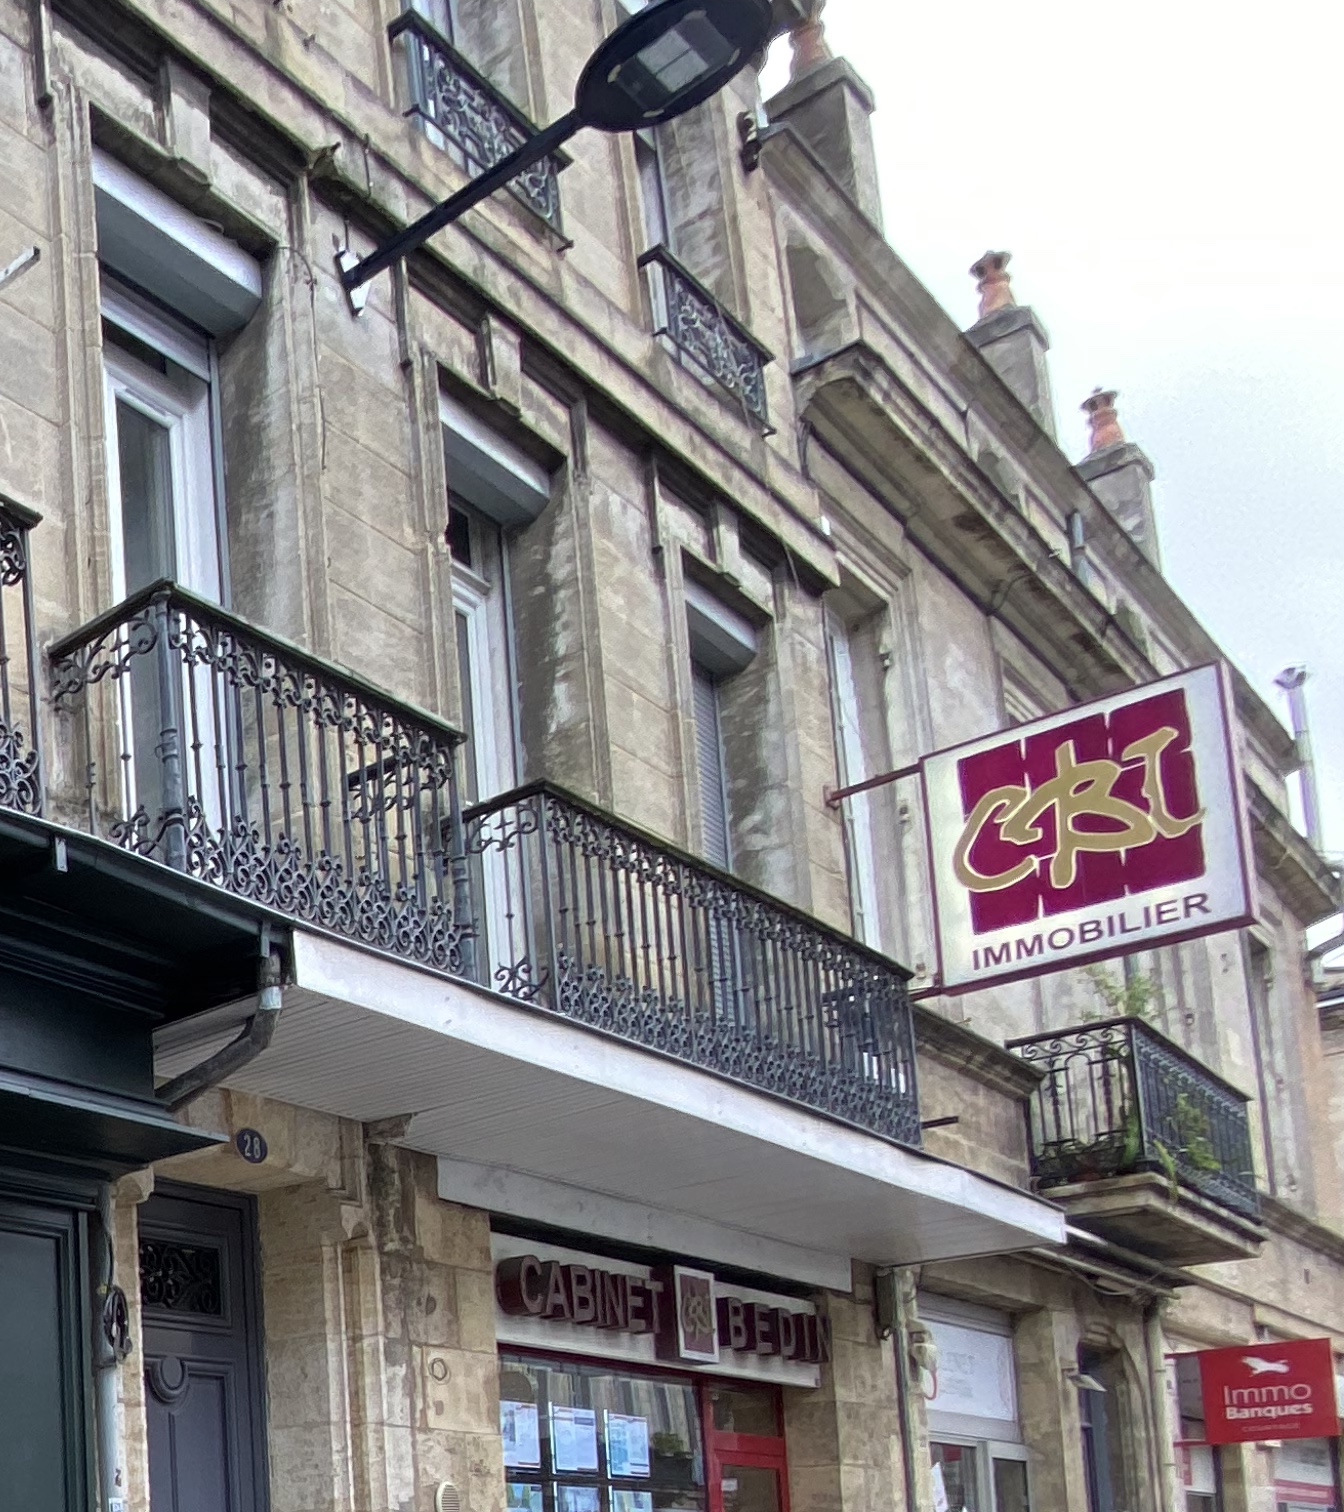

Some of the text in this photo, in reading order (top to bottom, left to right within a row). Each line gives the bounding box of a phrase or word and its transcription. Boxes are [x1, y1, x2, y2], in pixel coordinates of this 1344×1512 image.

[971, 892, 1211, 972] IMMOBILIER
[243, 1133, 261, 1159] 28
[502, 1254, 664, 1335] CABINET
[717, 1296, 833, 1364] BEDIN
[1225, 1403, 1313, 1419] Banques
